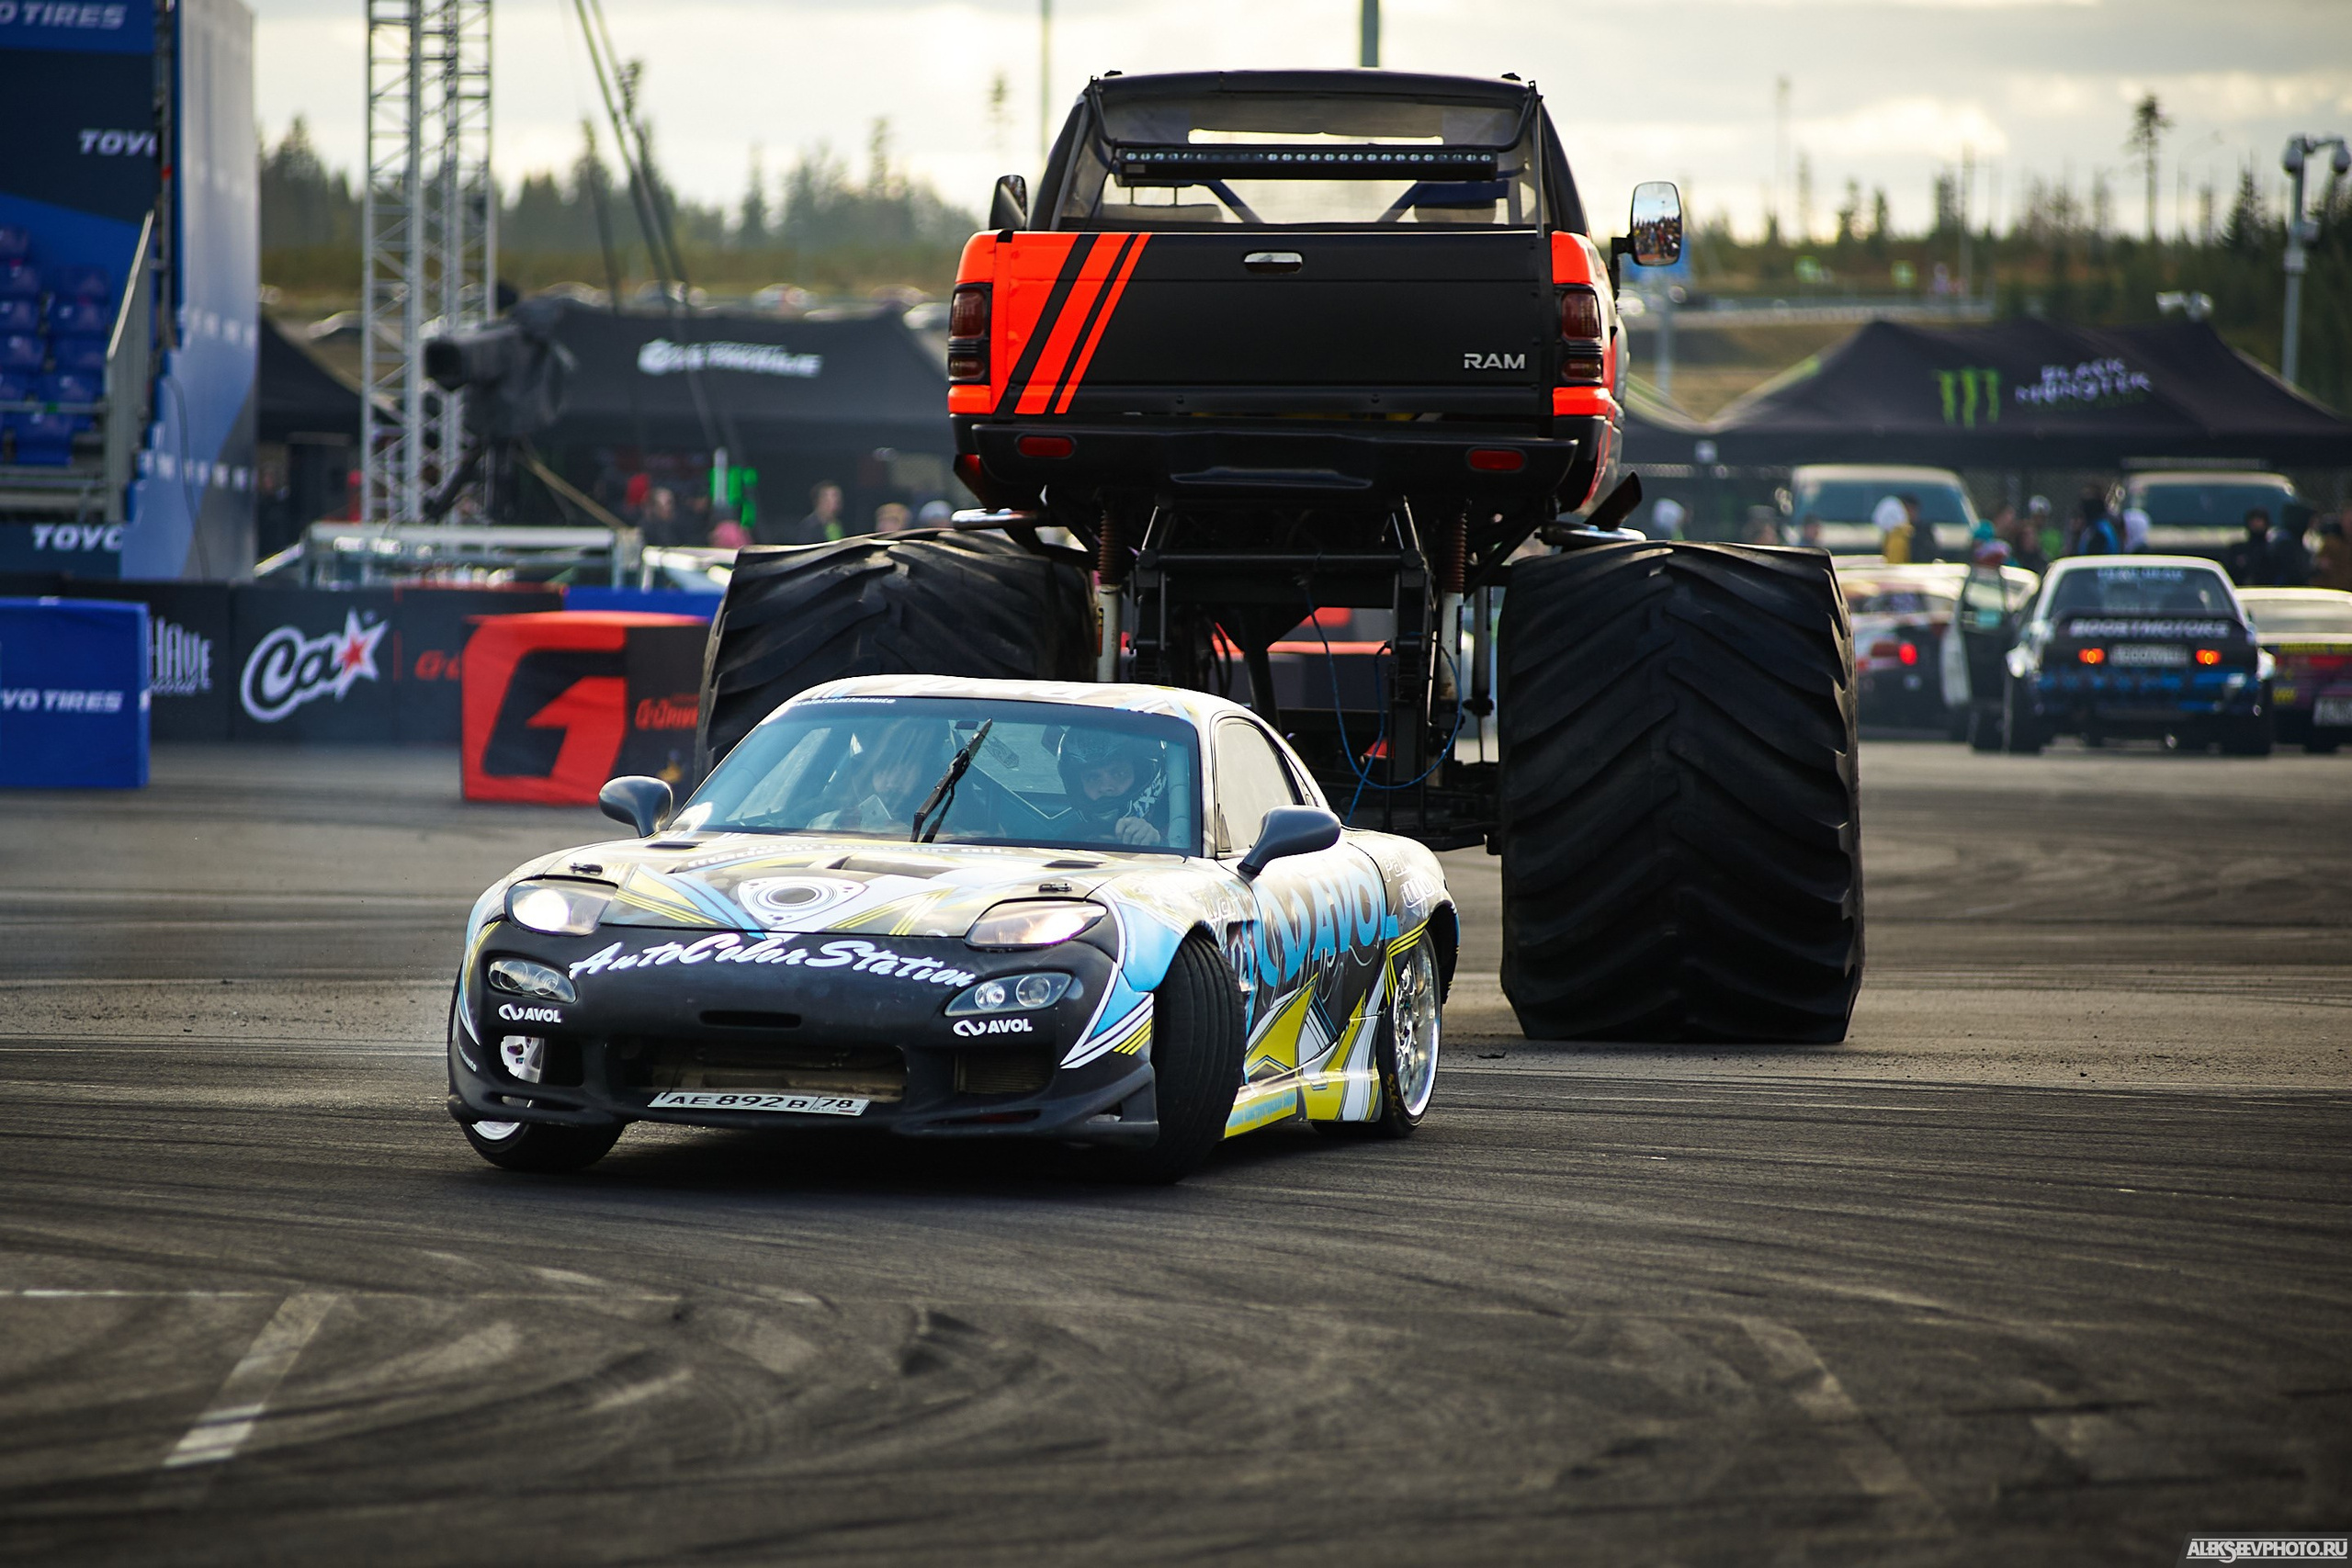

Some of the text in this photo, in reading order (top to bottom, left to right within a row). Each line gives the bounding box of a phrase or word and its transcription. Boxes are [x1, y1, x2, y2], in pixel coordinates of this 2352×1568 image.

[23, 5, 127, 29] TIRES
[1464, 354, 1525, 368] RAM
[42, 690, 123, 712] TIRES
[1309, 860, 1399, 962] AVOL
[524, 1007, 562, 1023] AVOL
[987, 1018, 1033, 1033] AVOL
